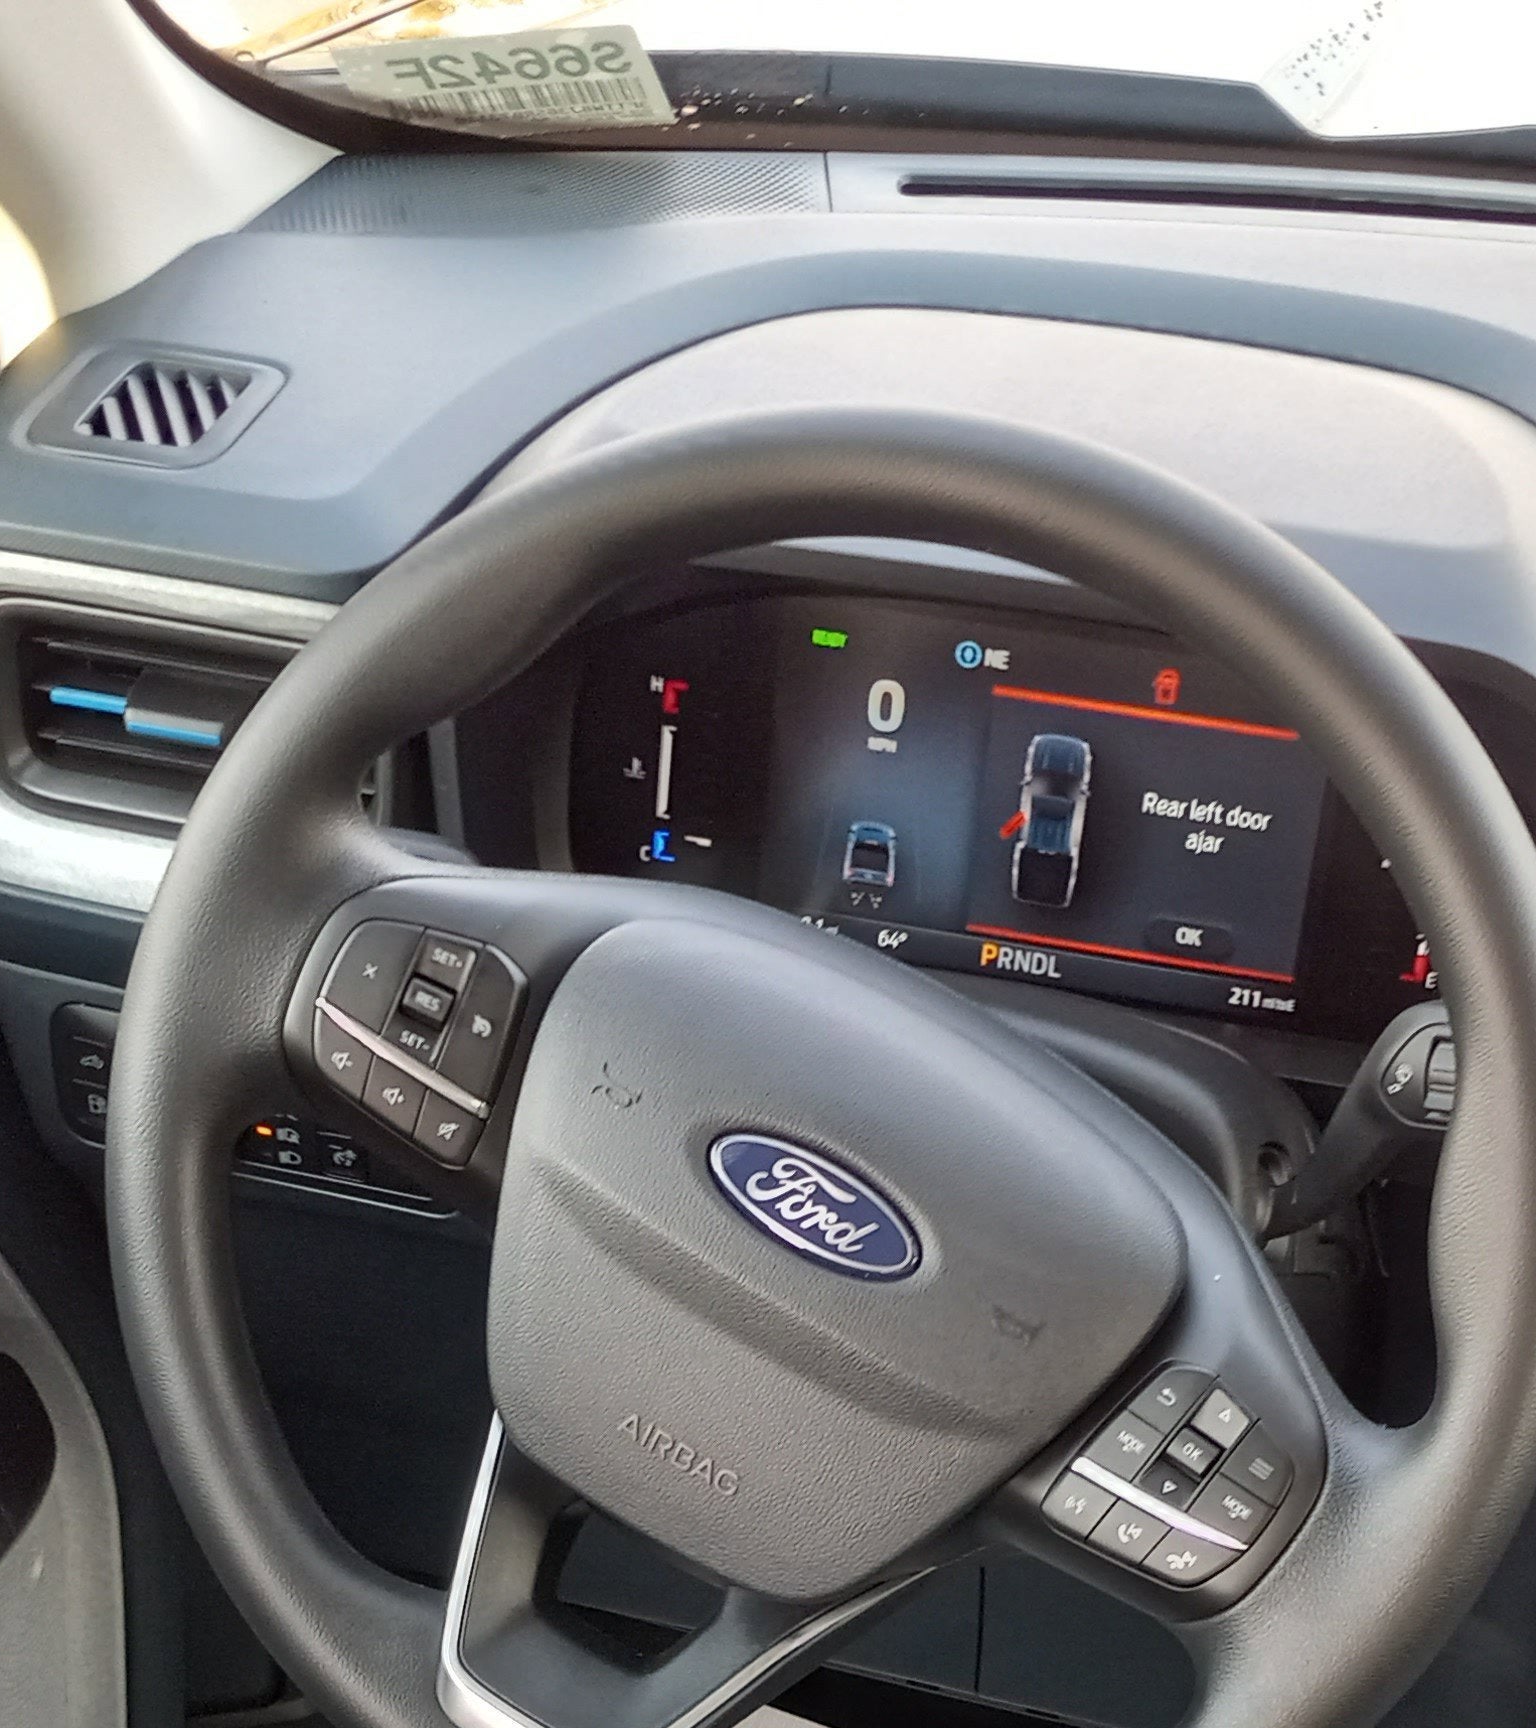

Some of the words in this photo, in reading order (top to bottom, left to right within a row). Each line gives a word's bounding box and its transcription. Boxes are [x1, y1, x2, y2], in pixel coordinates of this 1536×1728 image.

[651, 675, 664, 693] H
[867, 679, 905, 733] 0
[1141, 791, 1186, 820] Rear
[1188, 799, 1224, 825] left
[1225, 805, 1273, 832] door
[1184, 829, 1224, 855] ajar
[1175, 926, 1204, 948] OK
[980, 942, 1062, 979] PRNDL
[1425, 971, 1440, 989] E
[1228, 986, 1262, 1008] 211
[745, 1157, 880, 1253] Ford
[617, 1413, 740, 1496] AIRBAG
[1183, 1442, 1203, 1460] OK
